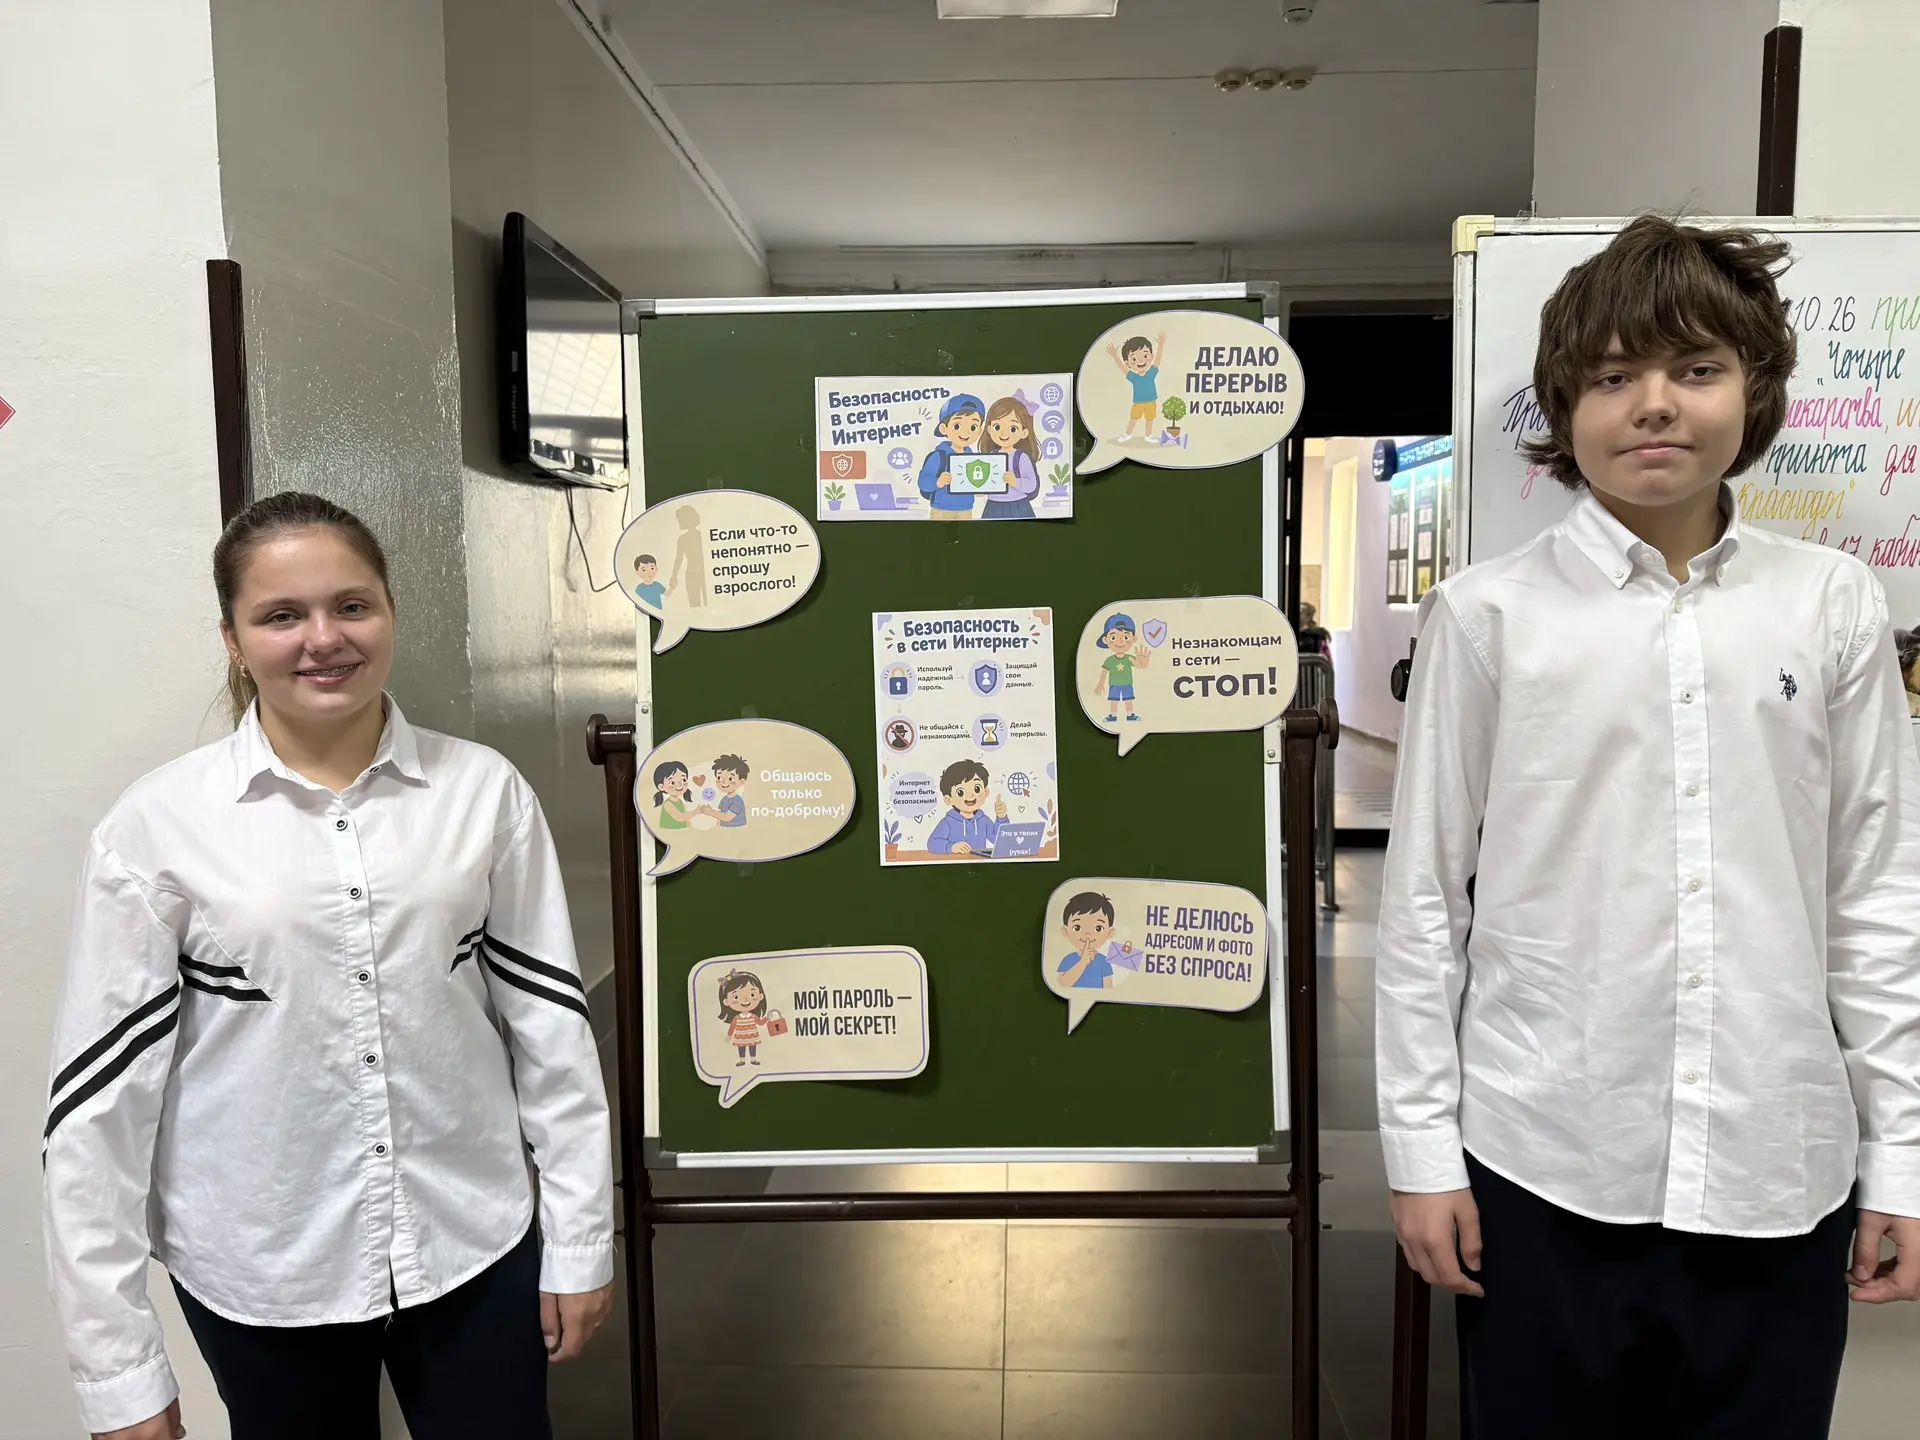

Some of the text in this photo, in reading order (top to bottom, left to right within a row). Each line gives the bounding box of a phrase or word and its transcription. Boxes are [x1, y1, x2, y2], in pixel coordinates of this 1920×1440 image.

[1195, 346, 1280, 370] ДЕЛАЮ
[1185, 372, 1287, 394] ПЕРЕРЫВ
[828, 384, 951, 409] Безопасность
[1189, 399, 1285, 416] И ОТДЫХАЮ!
[831, 411, 889, 426] в сети
[832, 420, 922, 446] Интернет
[1765, 443, 1917, 496] приюта для
[709, 524, 798, 541] Если что-то
[711, 542, 792, 559] непонятно
[712, 562, 770, 578] спрошу
[714, 576, 796, 596] взрослого!
[904, 618, 1020, 637] Безопасность
[897, 635, 1030, 653] в сети Интернет
[1171, 636, 1282, 650] Незнакомцам
[1005, 662, 1038, 670] Защищай
[1172, 657, 1181, 667] в
[1185, 655, 1220, 666] сети
[917, 665, 953, 674] Используй
[918, 674, 954, 682] надежный
[1005, 681, 1034, 689] данные.
[918, 684, 944, 692] пароль.
[929, 723, 959, 732] общайся
[1010, 721, 1032, 729] Делай
[919, 733, 972, 741] незнакомцами.
[1010, 730, 1048, 739] перерывы.
[760, 769, 832, 784] Общаюсь
[898, 779, 931, 787] Интернет
[771, 788, 822, 799] только
[918, 788, 935, 796] быть
[893, 797, 938, 806] безопасным!
[751, 804, 845, 819] по-доброму!
[1146, 905, 1254, 935] НЕ ДЕЛЮСЬ
[1145, 933, 1253, 956] АДРЕСОМ И ФОТО
[1145, 954, 1252, 983] БЕЗ СПРОСА!
[794, 986, 828, 1010] МОЙ
[833, 989, 894, 1009] ПАРОЛЬ
[795, 1013, 896, 1037] МОЙ СЕКРЕТ!
